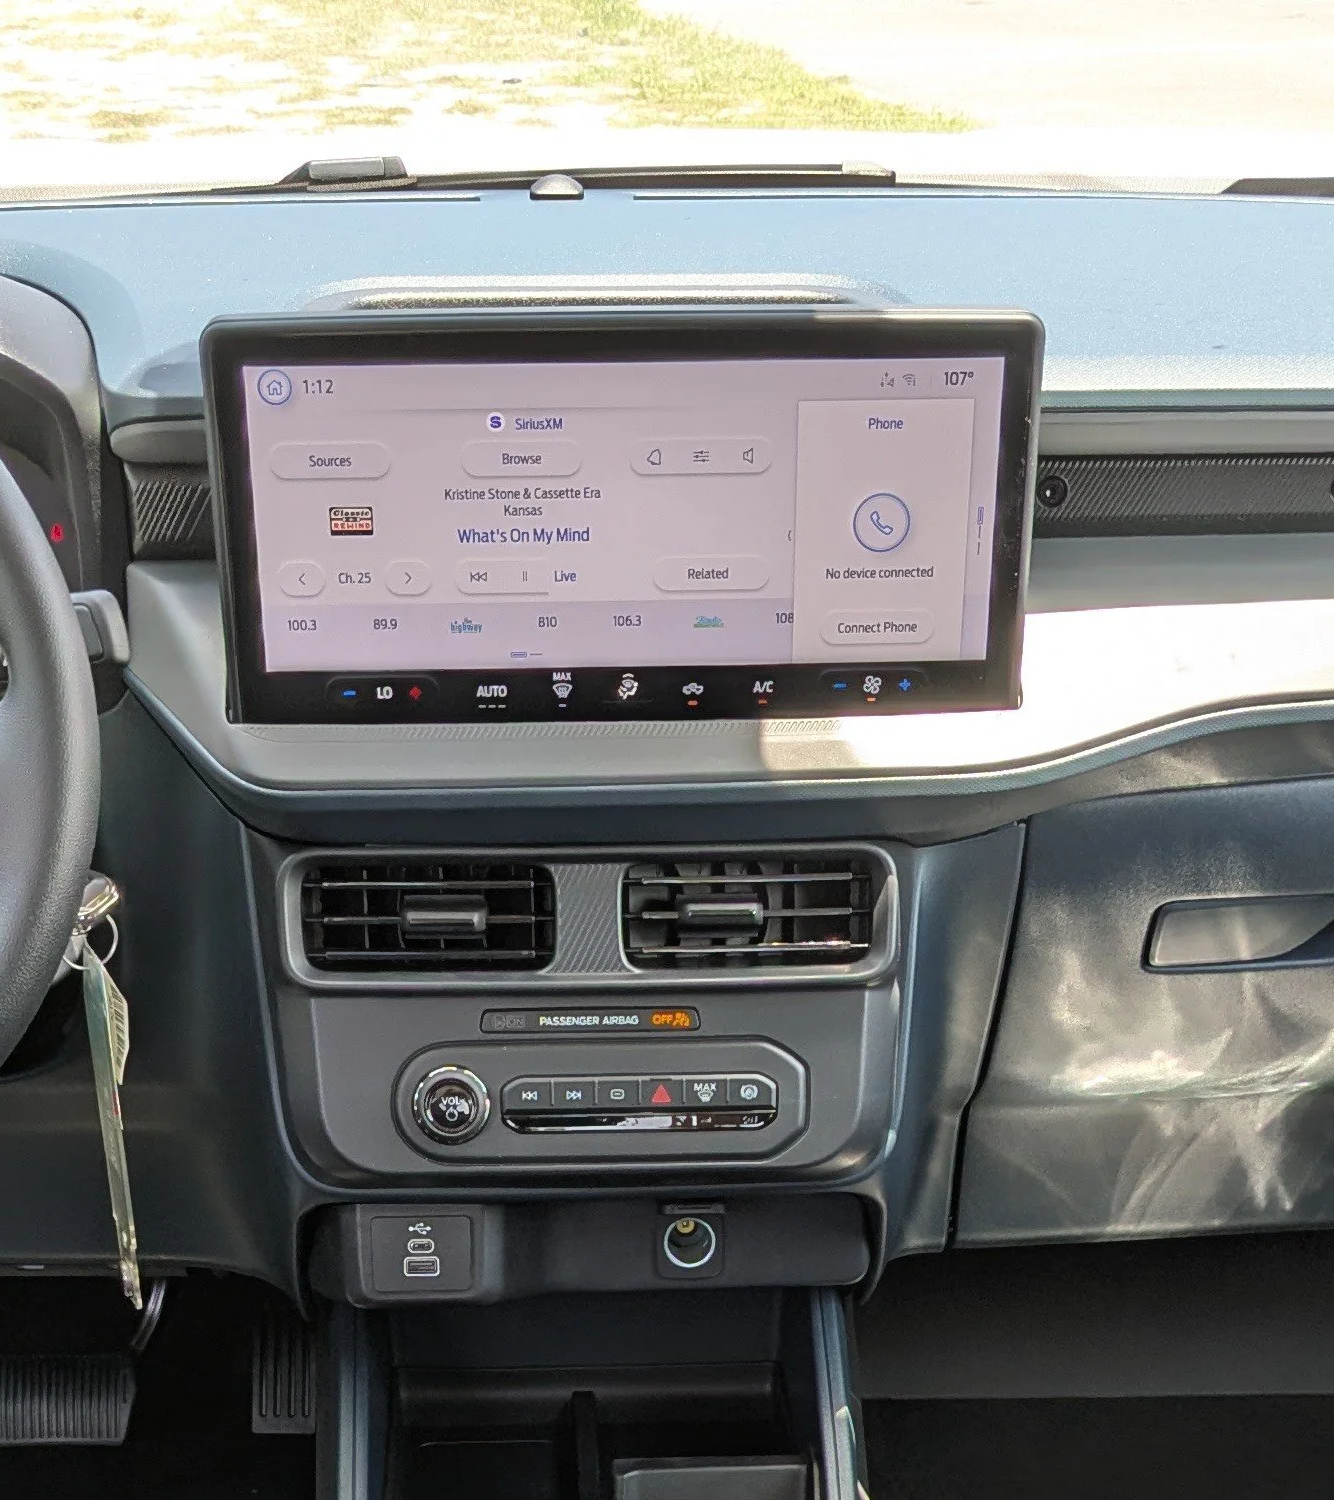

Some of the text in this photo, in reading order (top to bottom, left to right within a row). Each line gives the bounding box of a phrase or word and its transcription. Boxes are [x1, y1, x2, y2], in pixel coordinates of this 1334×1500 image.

[303, 379, 334, 395] 1:12
[515, 417, 563, 431] SiriusXM
[868, 418, 904, 431] Phone
[309, 454, 352, 468] Sources
[501, 452, 542, 466] Browse
[444, 486, 602, 501] Kristine Stone & Cassette Era
[503, 504, 543, 517] Kansas
[333, 522, 371, 530] REWIND
[457, 528, 590, 546] What's On My Mind
[338, 572, 372, 585] Ch. 25
[554, 569, 577, 583] Live
[687, 567, 729, 581] Related
[826, 566, 934, 579] No device connected
[287, 619, 317, 632] 100.3
[373, 619, 398, 631] 89.9
[538, 616, 558, 628] 810
[612, 615, 642, 628] 106.3
[837, 621, 918, 635] Connect Phone
[552, 672, 572, 682] MAX
[376, 686, 393, 699] LO
[476, 685, 508, 699] AUTO
[753, 680, 774, 693] A/C
[539, 1015, 600, 1026] PASSENGER
[602, 1015, 639, 1025] AIRBAG
[652, 1014, 673, 1025] OFF
[694, 1083, 717, 1092] MAX
[442, 1096, 461, 1106] VOL
